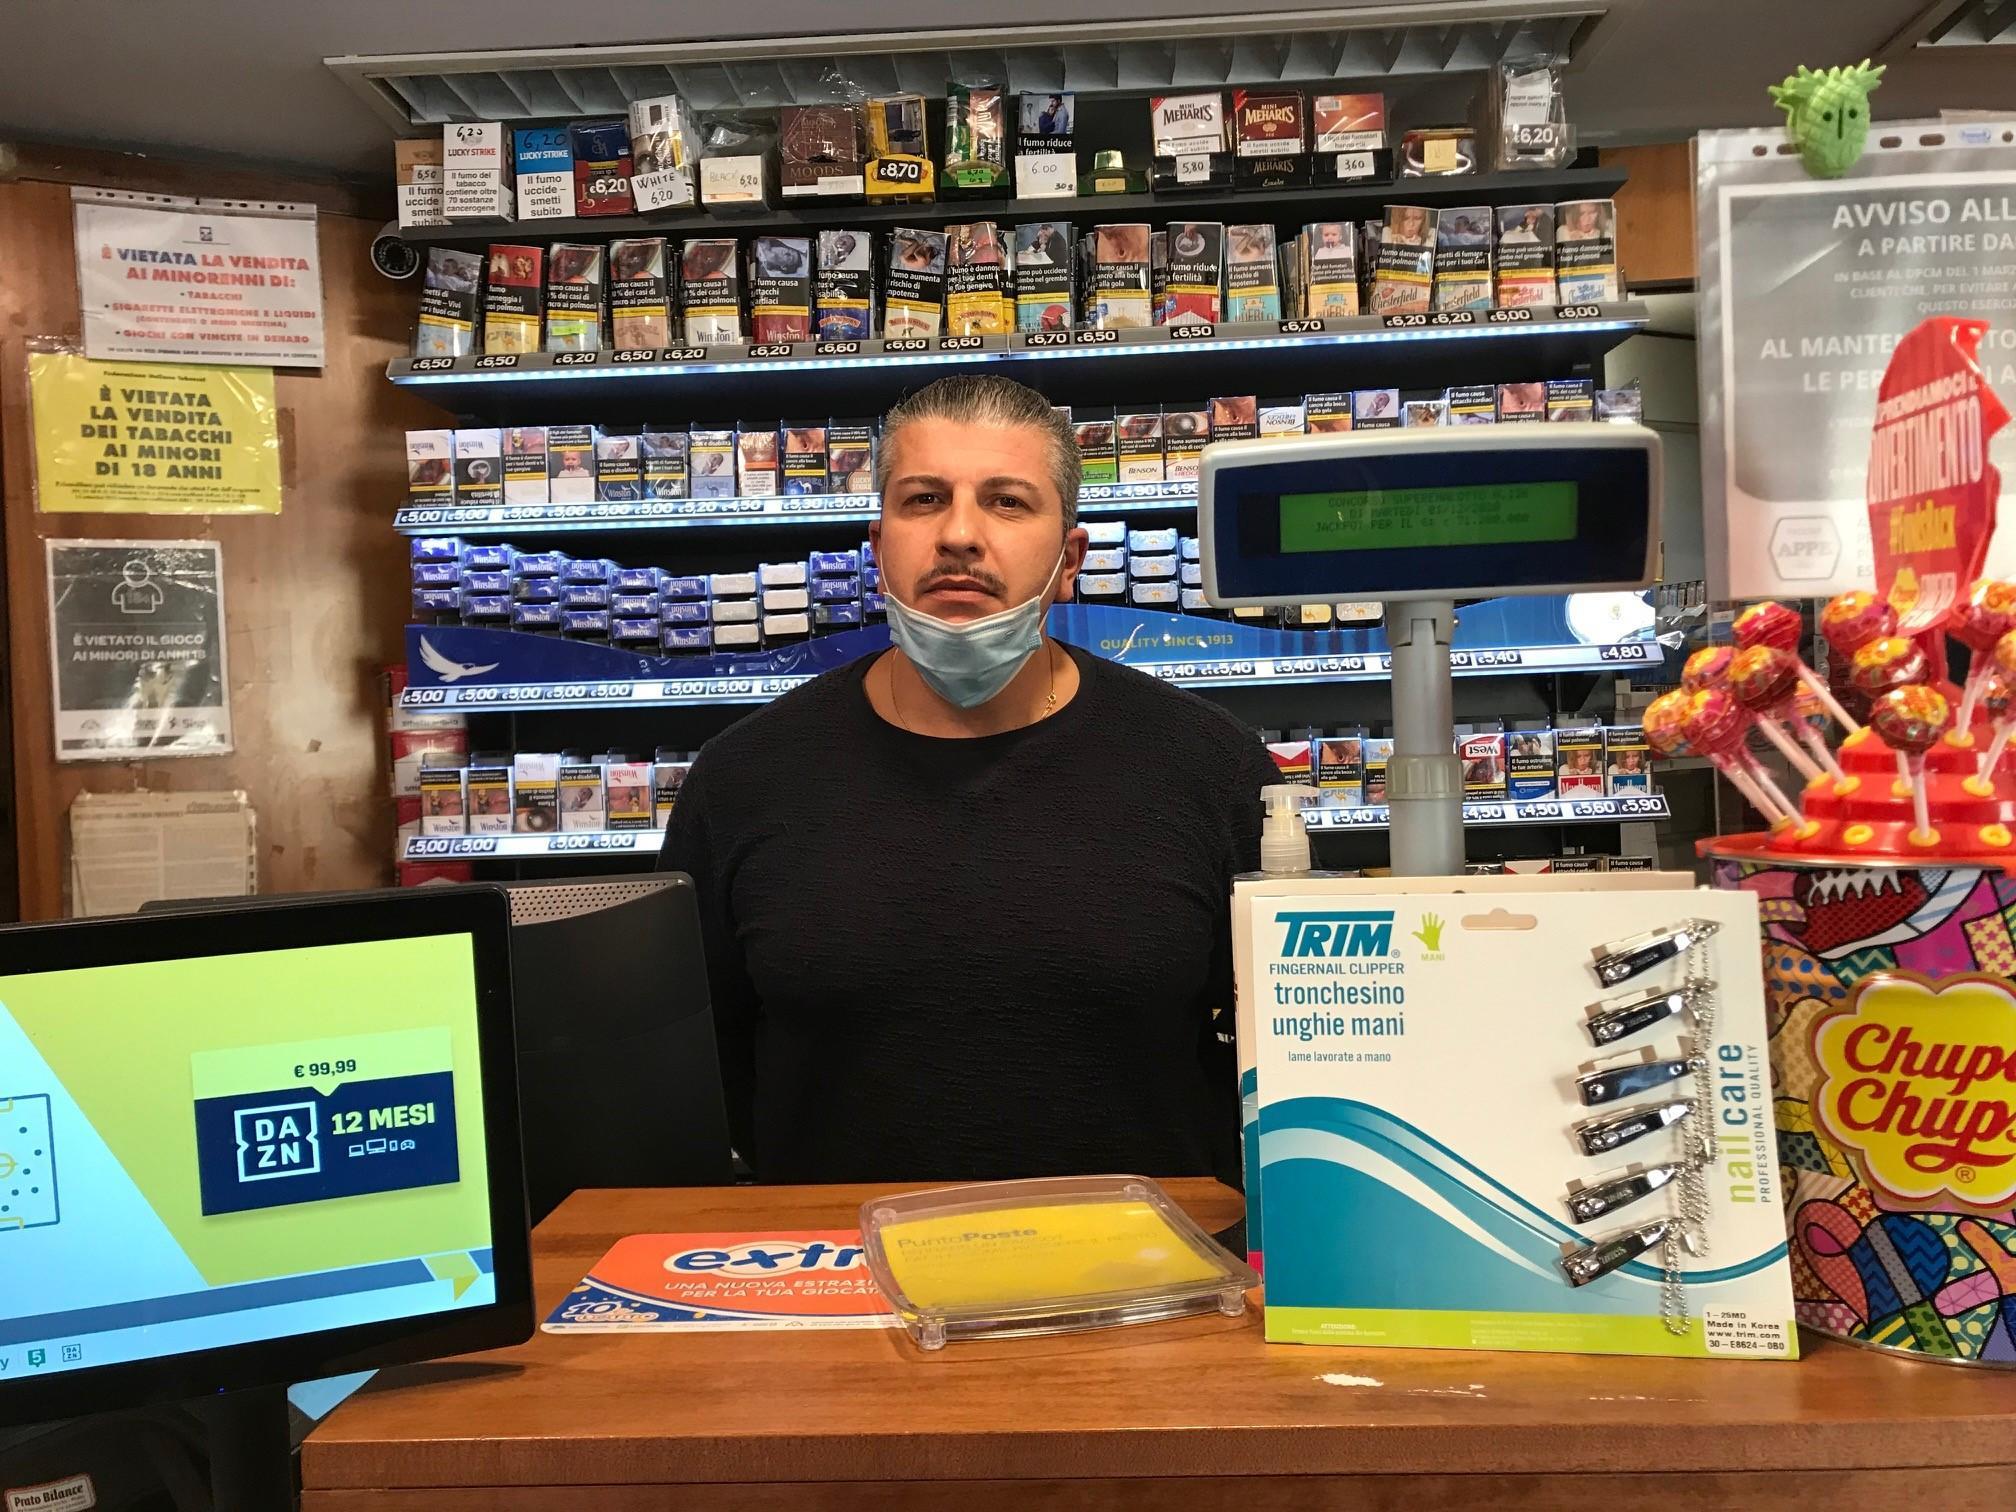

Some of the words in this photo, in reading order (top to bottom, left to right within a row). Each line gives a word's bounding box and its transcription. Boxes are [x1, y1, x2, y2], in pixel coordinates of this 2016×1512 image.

[456, 126, 484, 141] 6,20
[1023, 138, 1045, 148] fumo
[1045, 138, 1072, 148] riduce
[448, 149, 470, 157] LUCKY
[471, 148, 497, 156] STRIKE
[519, 152, 543, 161] LUCKY
[543, 150, 569, 159] STRIKE
[790, 165, 844, 178] MOODS
[880, 162, 919, 181] €8,70
[535, 175, 562, 184] fumo
[636, 172, 675, 189] WHITE
[417, 186, 444, 196] fumo
[445, 188, 478, 196] contiene
[524, 186, 558, 195] uccide
[589, 178, 628, 195] €6,20
[405, 196, 439, 207] uccide
[530, 196, 561, 206] smetti
[446, 204, 496, 213] cancerogene
[530, 207, 562, 217] subito
[1832, 199, 1950, 229] AVVISO
[1858, 238, 1875, 256] A
[1881, 233, 1976, 255] PARTIRE
[117, 248, 197, 266] VIETATA
[201, 254, 225, 268] LA
[228, 255, 310, 271] VENDITA
[1171, 263, 1191, 272] fumo
[1192, 262, 1218, 273] riduce
[126, 267, 148, 280] AI
[152, 269, 266, 287] MINORENNI
[270, 275, 296, 288] DI:
[1172, 273, 1202, 283] fertilità
[187, 291, 243, 301] TABACCHI
[1432, 312, 1472, 325] €6,20
[1490, 310, 1530, 322] €6,00
[1558, 306, 1598, 319] €6,00
[1282, 320, 1321, 332] €6,70
[1386, 314, 1426, 327] €6,20
[766, 329, 801, 341] Winston
[1077, 331, 1116, 343] €6,50
[1173, 326, 1212, 337] €6,50
[941, 337, 981, 349] €6,60
[1028, 333, 1067, 345] €6,70
[750, 345, 790, 357] €6,20
[818, 342, 857, 354] €6,60
[886, 340, 926, 351] €6,60
[1760, 338, 1792, 360] AL
[556, 353, 595, 364] €6,20
[612, 351, 653, 362] €6,50
[665, 348, 705, 359] €6,20
[413, 359, 452, 370] €6,50
[476, 356, 516, 367] €6,50
[1804, 372, 1831, 392] LE
[100, 385, 111, 401] È
[121, 388, 212, 407] VIETATA
[91, 407, 118, 421] LA
[126, 408, 222, 426] VENDITA
[81, 425, 118, 439] DEI
[126, 426, 232, 444] TABACCHI
[103, 444, 127, 457] AI
[137, 445, 221, 462] MINORI
[96, 462, 119, 476] DI
[131, 463, 156, 477] 18
[167, 465, 222, 479] ANNI
[1128, 466, 1157, 475] BENSON
[828, 497, 867, 508] €5,00
[401, 511, 440, 522] €5,00
[821, 560, 847, 571] Winston
[472, 579, 499, 590] Winston
[84, 635, 144, 646] VIETATO
[146, 636, 158, 645] IL
[160, 634, 205, 645] GIOCO
[1101, 637, 1159, 651] QUALITY
[1163, 635, 1203, 647] SINCE
[1207, 635, 1234, 646] 1913
[72, 652, 87, 662] AI
[89, 651, 139, 662] MINORI
[141, 651, 155, 660] DI
[1478, 652, 1518, 664] €5,40
[1602, 646, 1644, 660] €4,80
[1157, 666, 1196, 678] €5,40
[1275, 660, 1315, 673] €5,40
[664, 682, 703, 694] €5,00
[405, 691, 444, 703] €5,00
[1469, 745, 1498, 755] West
[1519, 804, 1559, 817] €4,50
[1576, 801, 1616, 815] €5,60
[1621, 799, 1662, 812] €5,90
[1334, 810, 1373, 823] €5,40
[409, 841, 448, 853] €5,00
[1274, 910, 1395, 957] TRIM
[1269, 963, 1346, 975] FINGERNAIL
[1349, 963, 1405, 975] CLIPPER
[1274, 981, 1405, 1004] tronchesino
[1273, 1012, 1345, 1041] unghie
[1352, 1012, 1404, 1036] mani
[1288, 1051, 1312, 1062] lame
[1313, 1051, 1354, 1062] lavorate
[1364, 1054, 1391, 1062] mano
[294, 1064, 305, 1078] €
[309, 1059, 357, 1077] 99,99
[1747, 1045, 1763, 1099] QUALITY
[1717, 1044, 1749, 1126] care
[332, 1112, 363, 1135] 12
[369, 1102, 435, 1130] MESI
[1754, 1105, 1772, 1203] PROFESSIONAL
[1717, 1135, 1756, 1203] nail
[897, 1226, 1038, 1248] PuntoPoste
[673, 1243, 865, 1272] extr
[664, 1281, 708, 1292] UNA
[715, 1280, 786, 1291] NUOVA
[681, 1289, 717, 1298] PER
[723, 1289, 747, 1298] LA
[754, 1289, 794, 1298] TUA
[1751, 1322, 1780, 1330] Korea
[1708, 1331, 1780, 1339] www.trim.com
[42, 1484, 84, 1503] Bilance
